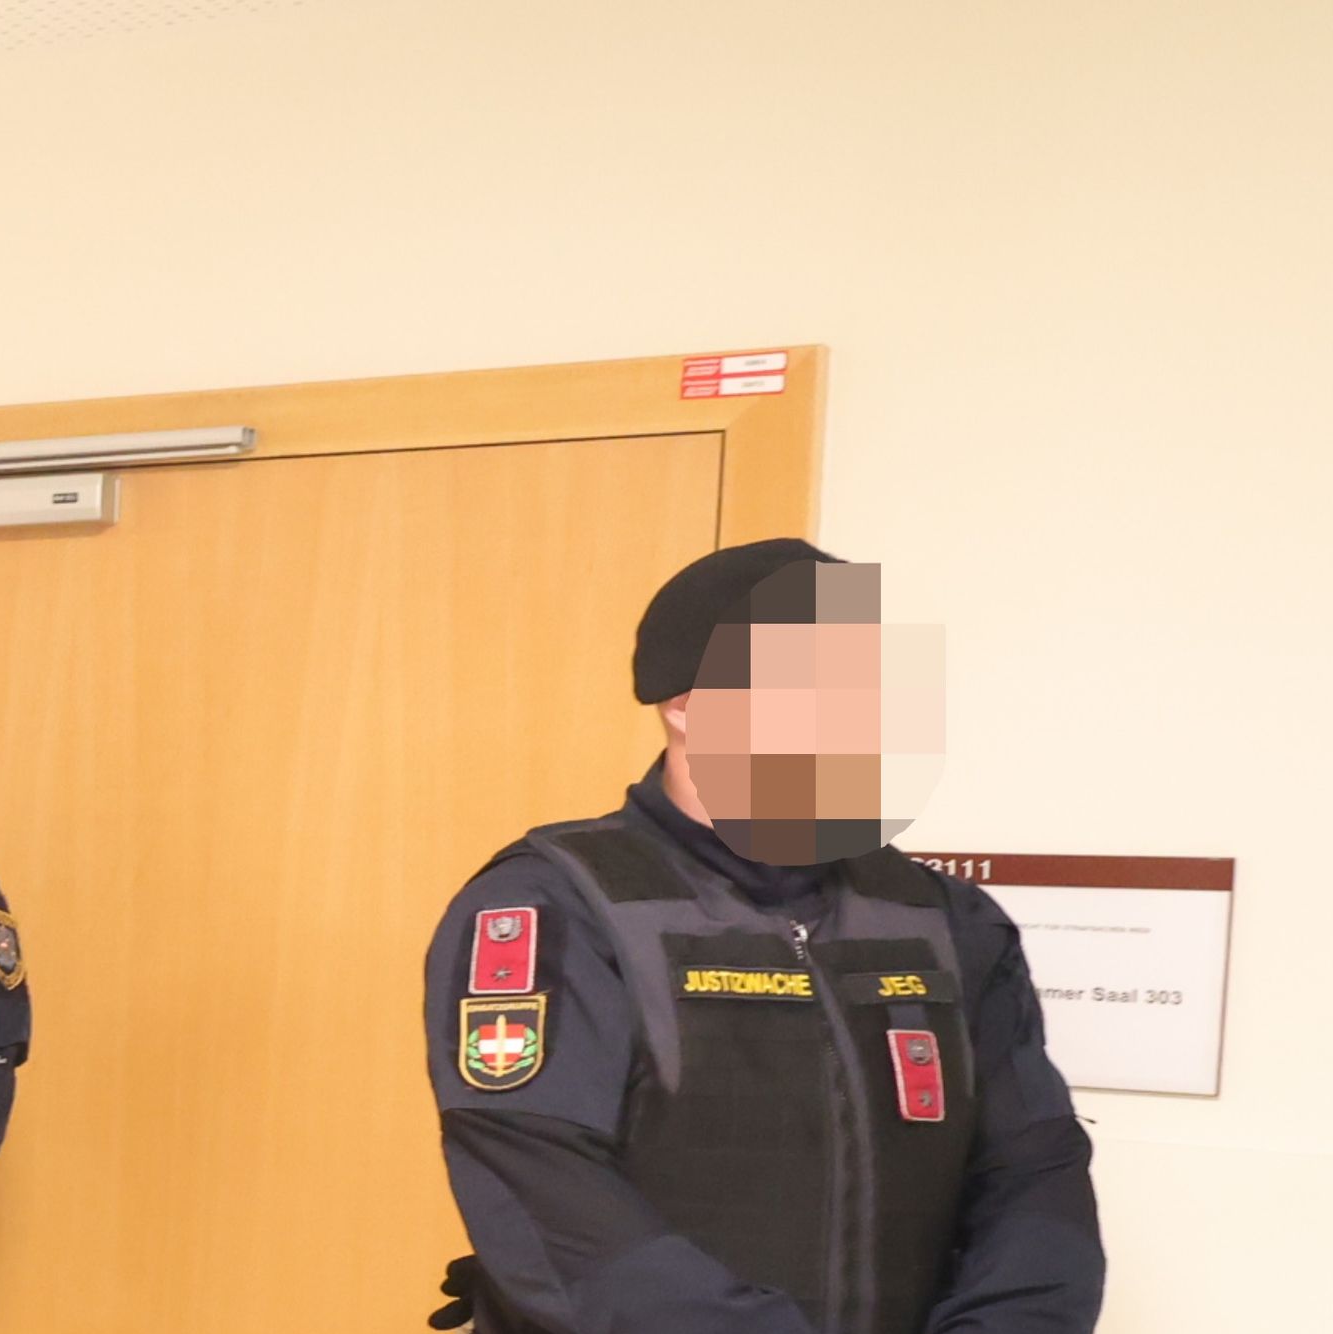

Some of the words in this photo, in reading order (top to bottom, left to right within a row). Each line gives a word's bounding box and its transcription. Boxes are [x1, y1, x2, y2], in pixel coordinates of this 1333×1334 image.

[910, 857, 991, 880] 3111
[684, 970, 813, 996] JUSTIZWACHE
[1092, 986, 1138, 1003] Saal
[1145, 989, 1183, 1006] 303
